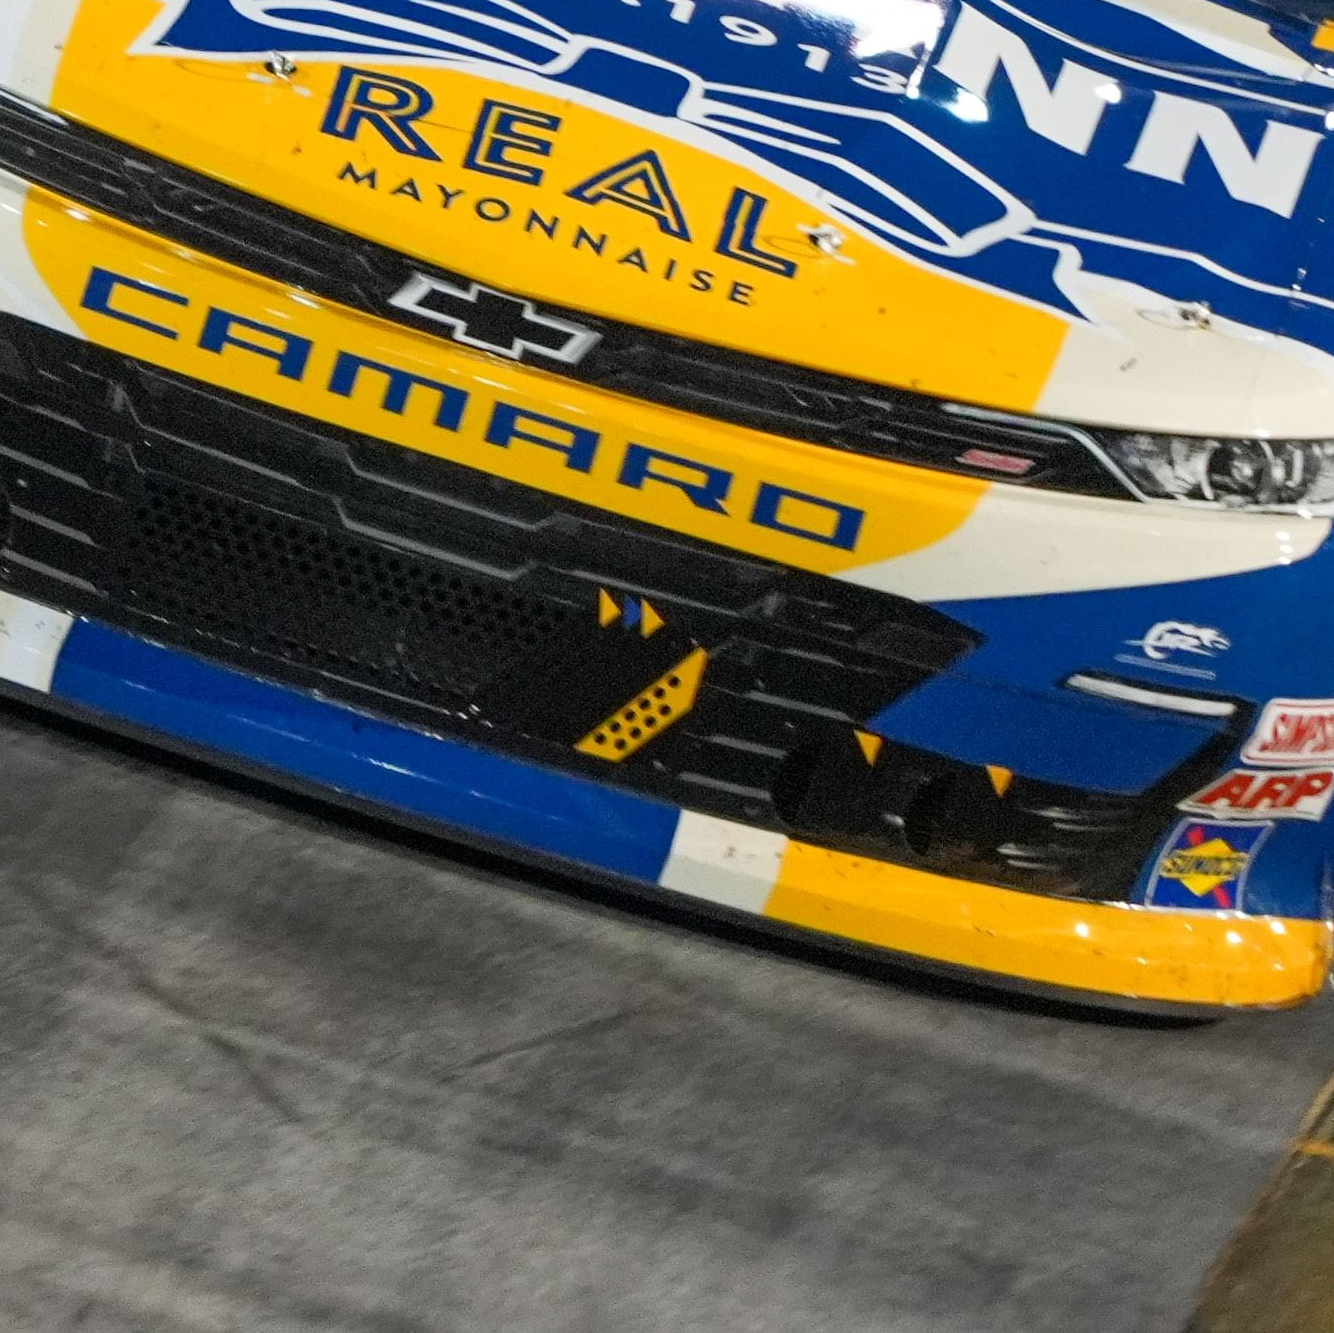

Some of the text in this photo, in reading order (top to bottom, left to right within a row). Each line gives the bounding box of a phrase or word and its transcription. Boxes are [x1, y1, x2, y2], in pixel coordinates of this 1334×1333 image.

[320, 66, 798, 279] REAL
[338, 162, 755, 307] MAYONNAISE
[81, 267, 865, 553] CAMARO
[1196, 770, 1334, 810] ARP
